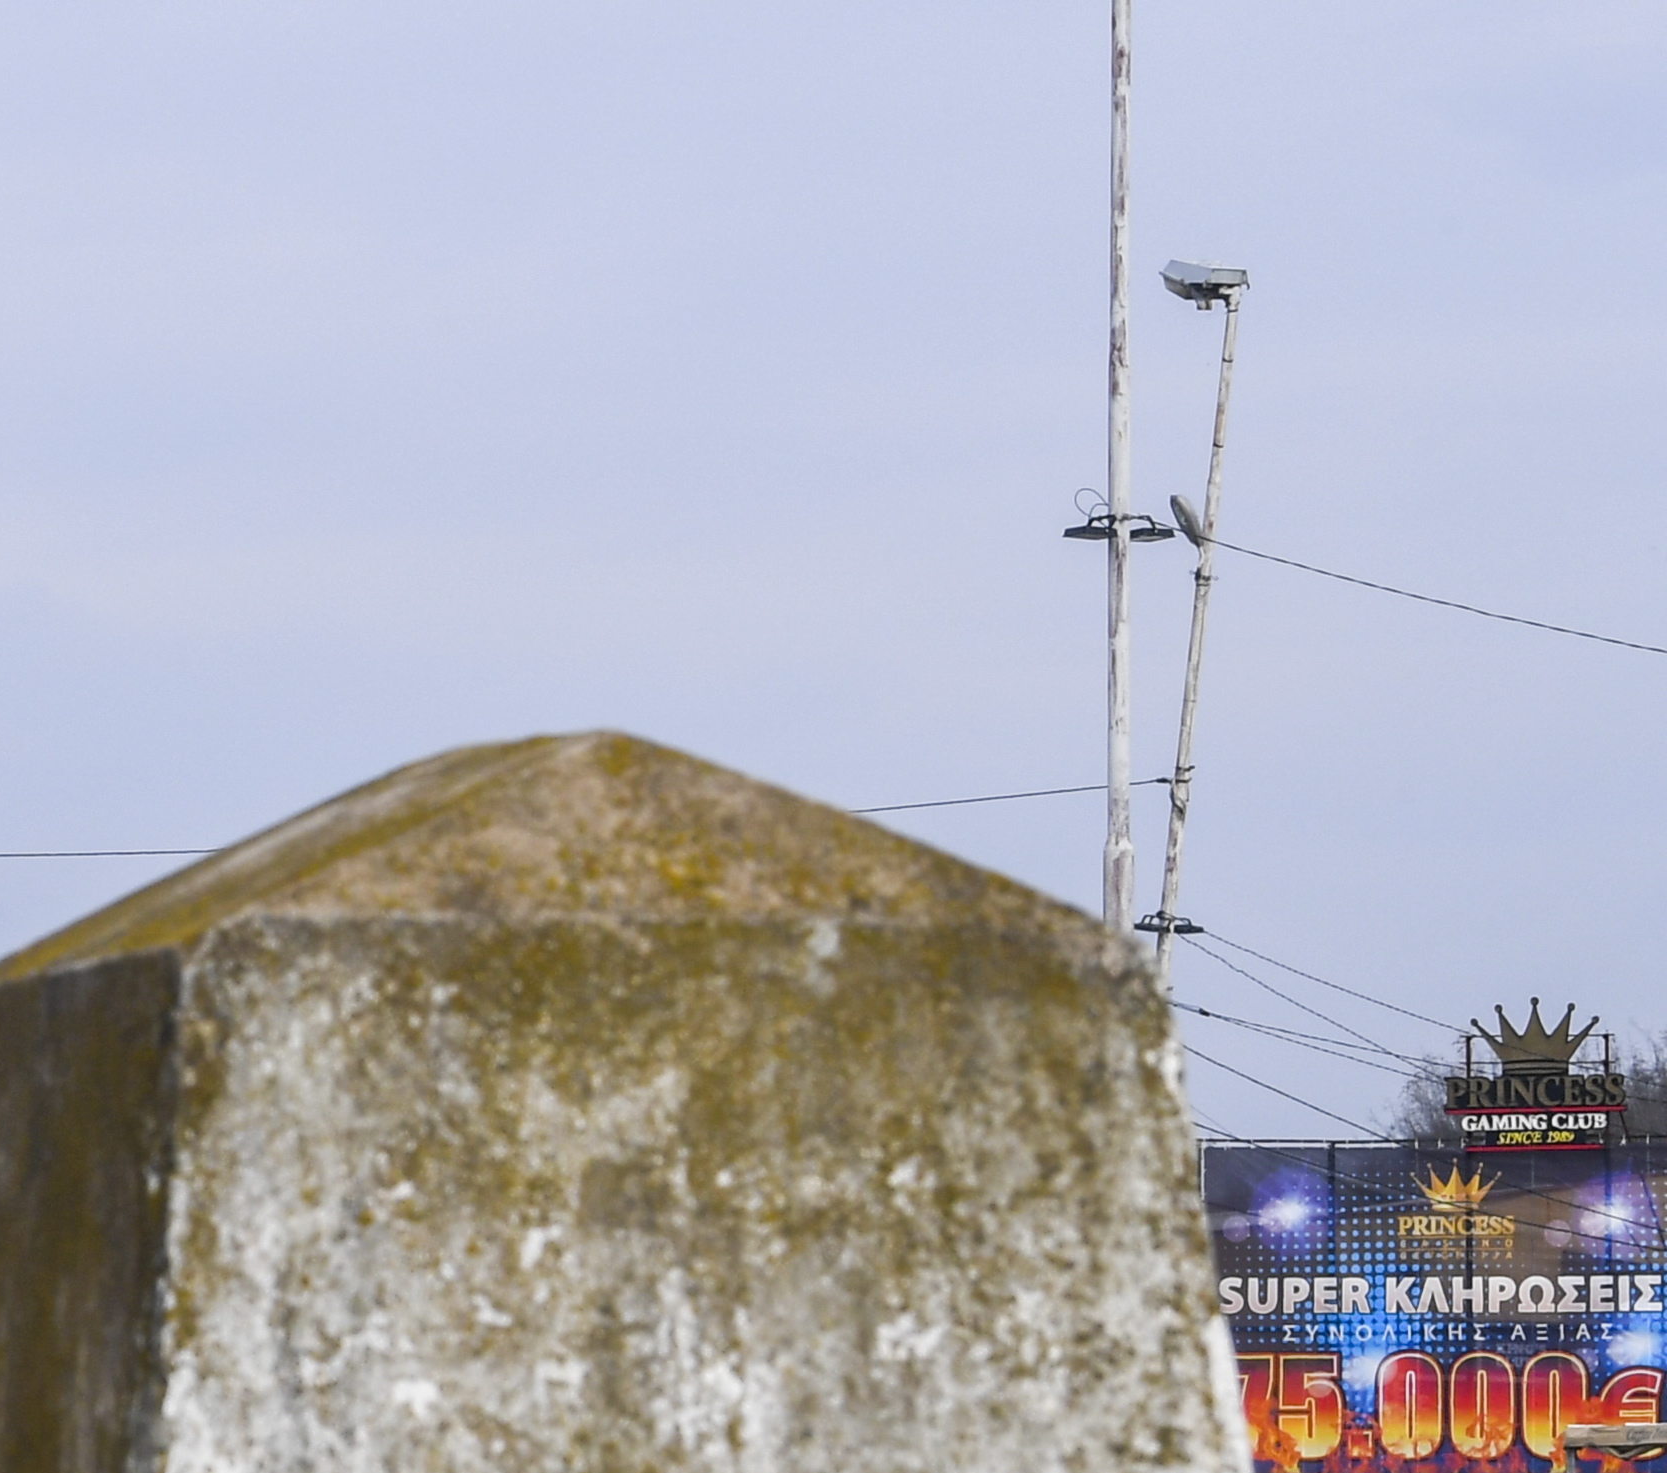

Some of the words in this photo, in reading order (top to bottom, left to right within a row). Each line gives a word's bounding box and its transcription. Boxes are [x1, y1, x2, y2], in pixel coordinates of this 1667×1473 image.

[1445, 1073, 1627, 1109] PRINCESS
[1461, 1113, 1548, 1132] GAMING
[1552, 1112, 1608, 1130] CLUB
[1496, 1132, 1543, 1145] SINCE
[1546, 1131, 1575, 1144] 1989
[1397, 1215, 1516, 1235] PRINCESS
[1218, 1276, 1372, 1314] SUPER
[1385, 1275, 1664, 1314] ΚΛΗΡΩΣΕΙΣ
[1281, 1323, 1487, 1341] ΣΥΝΟΛΙΚΗΣ
[1510, 1323, 1614, 1341] ΑΞΙΑΣ
